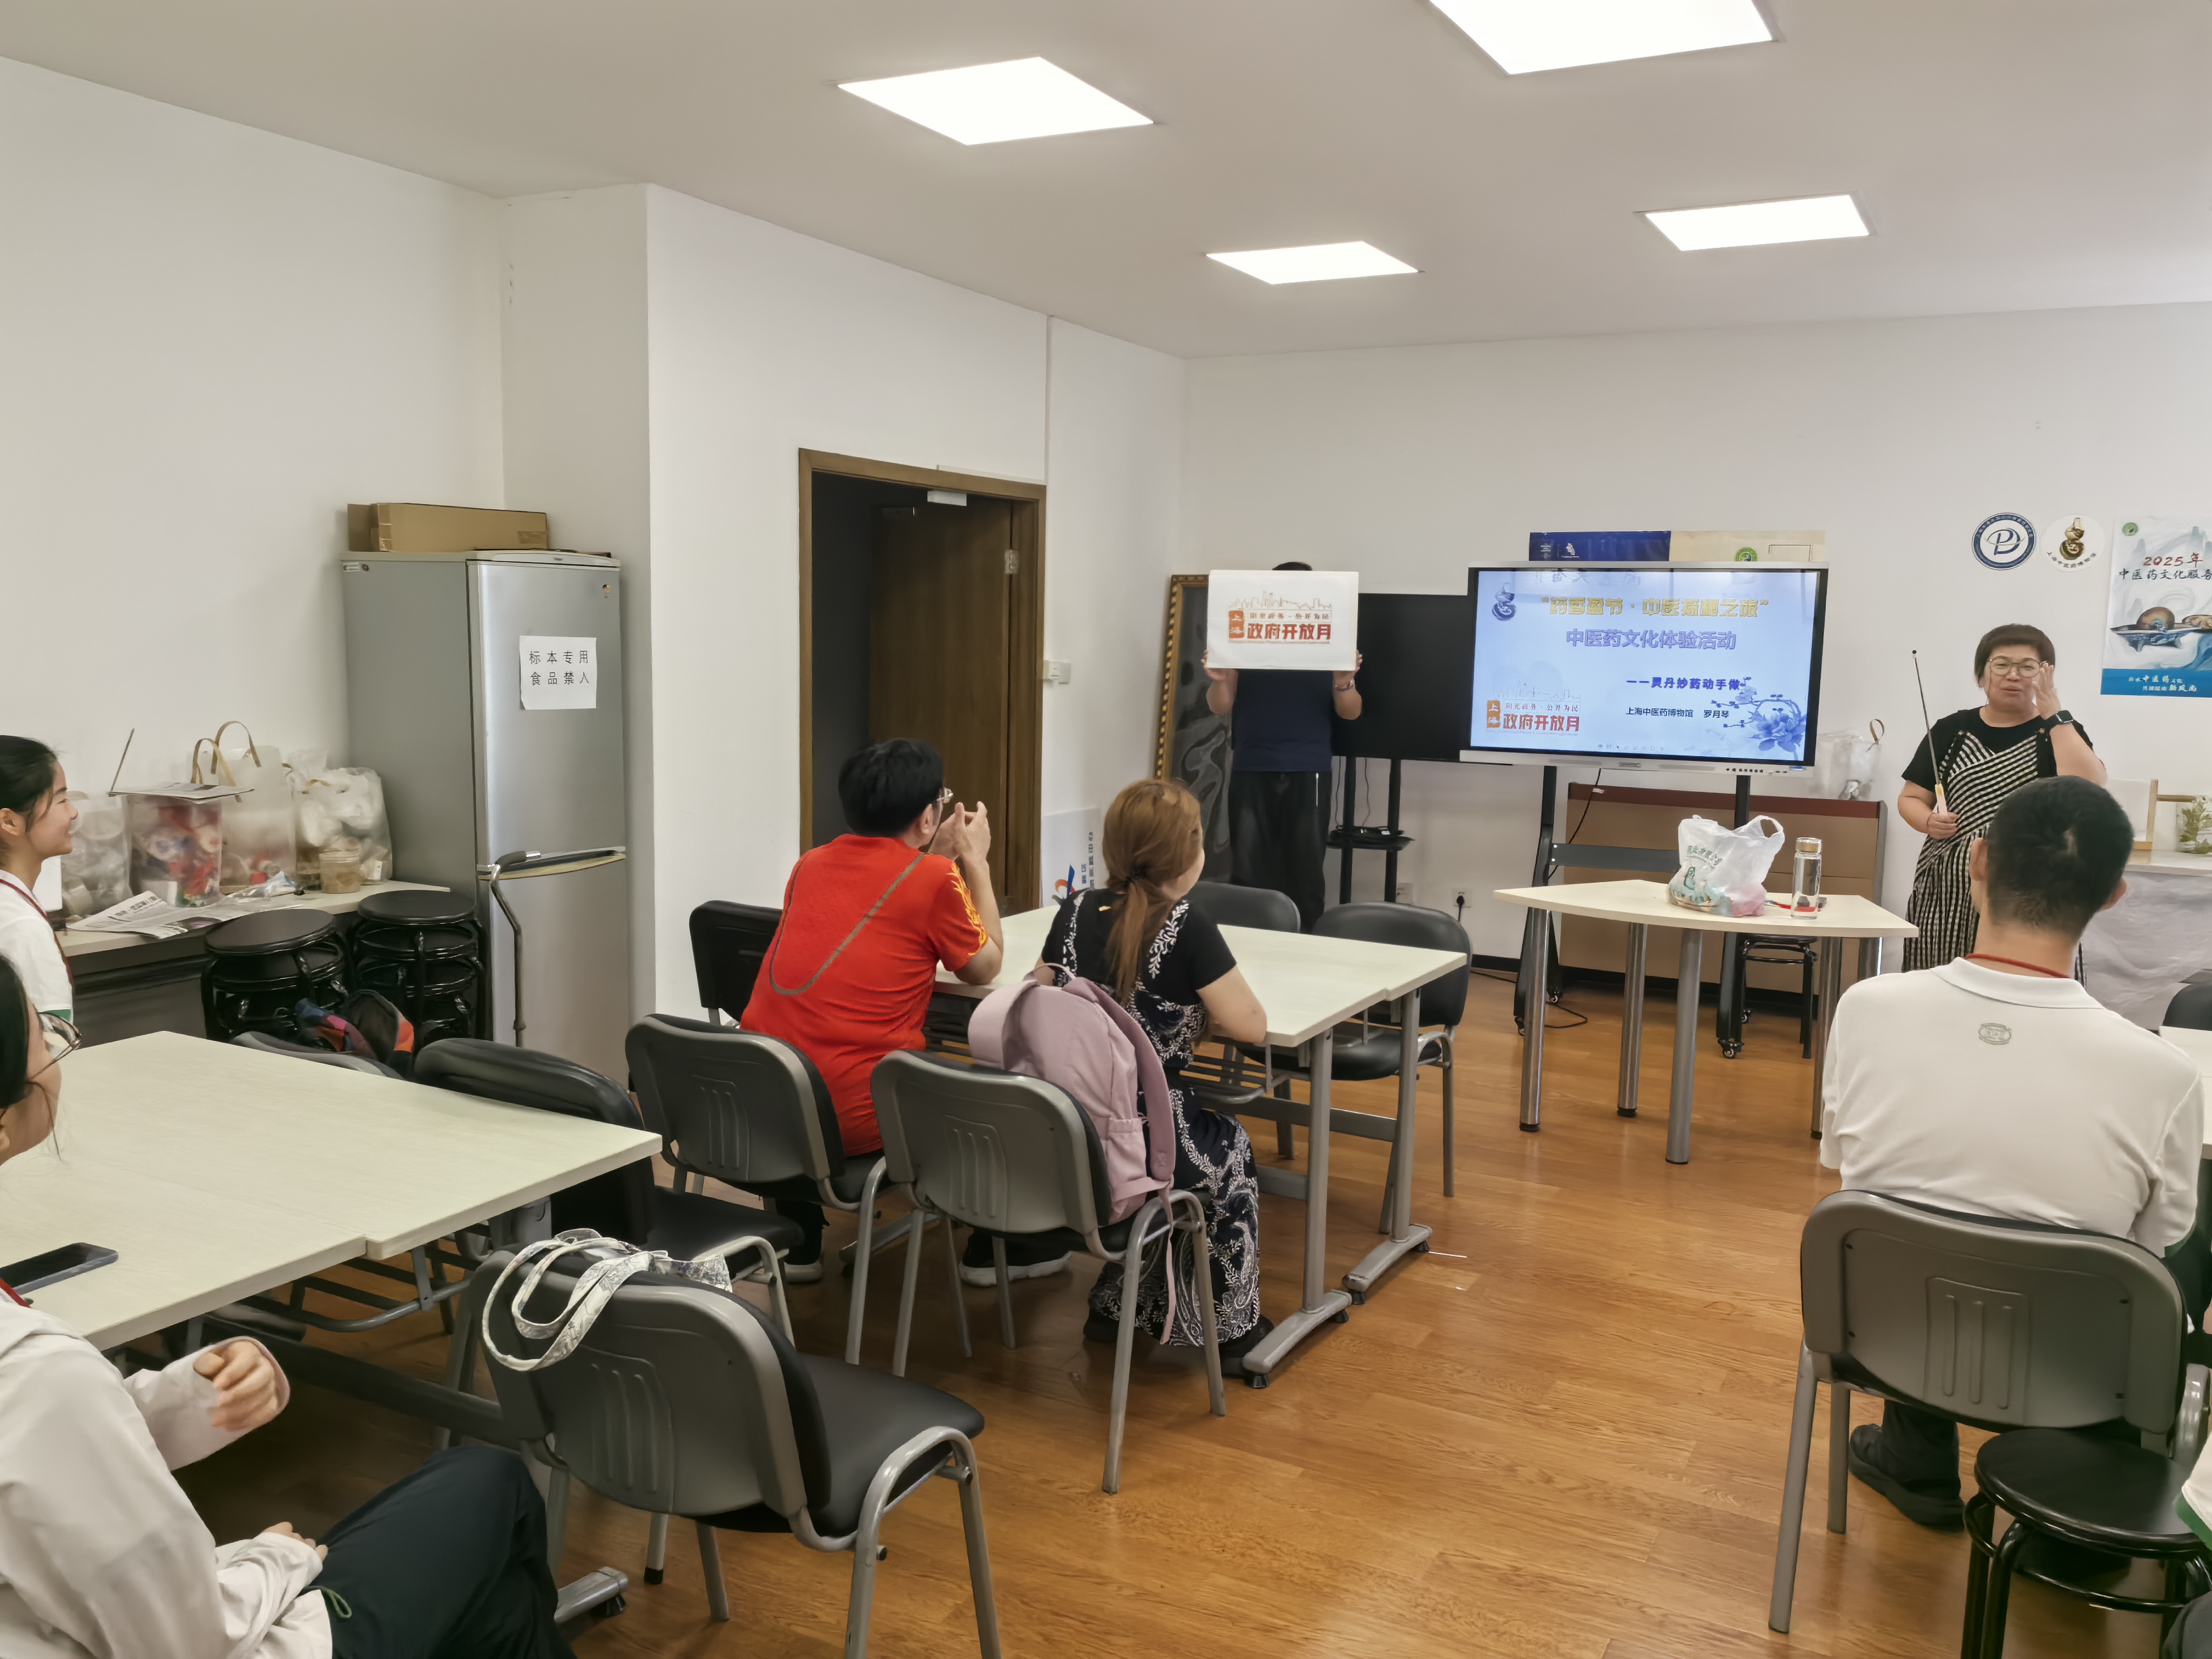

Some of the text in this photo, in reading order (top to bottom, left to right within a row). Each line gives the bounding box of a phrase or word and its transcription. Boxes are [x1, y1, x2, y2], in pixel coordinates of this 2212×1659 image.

[2143, 552, 2204, 568] 2025年
[1246, 623, 1331, 640] 政府开放月
[1566, 628, 1737, 650] 中医药文化体验活动
[529, 650, 589, 665] 标本专用
[530, 671, 590, 686] 食品禁入
[1626, 706, 1730, 719] 上海中医药博物馆 罗月琴
[1503, 713, 1580, 732] 政府开放月
